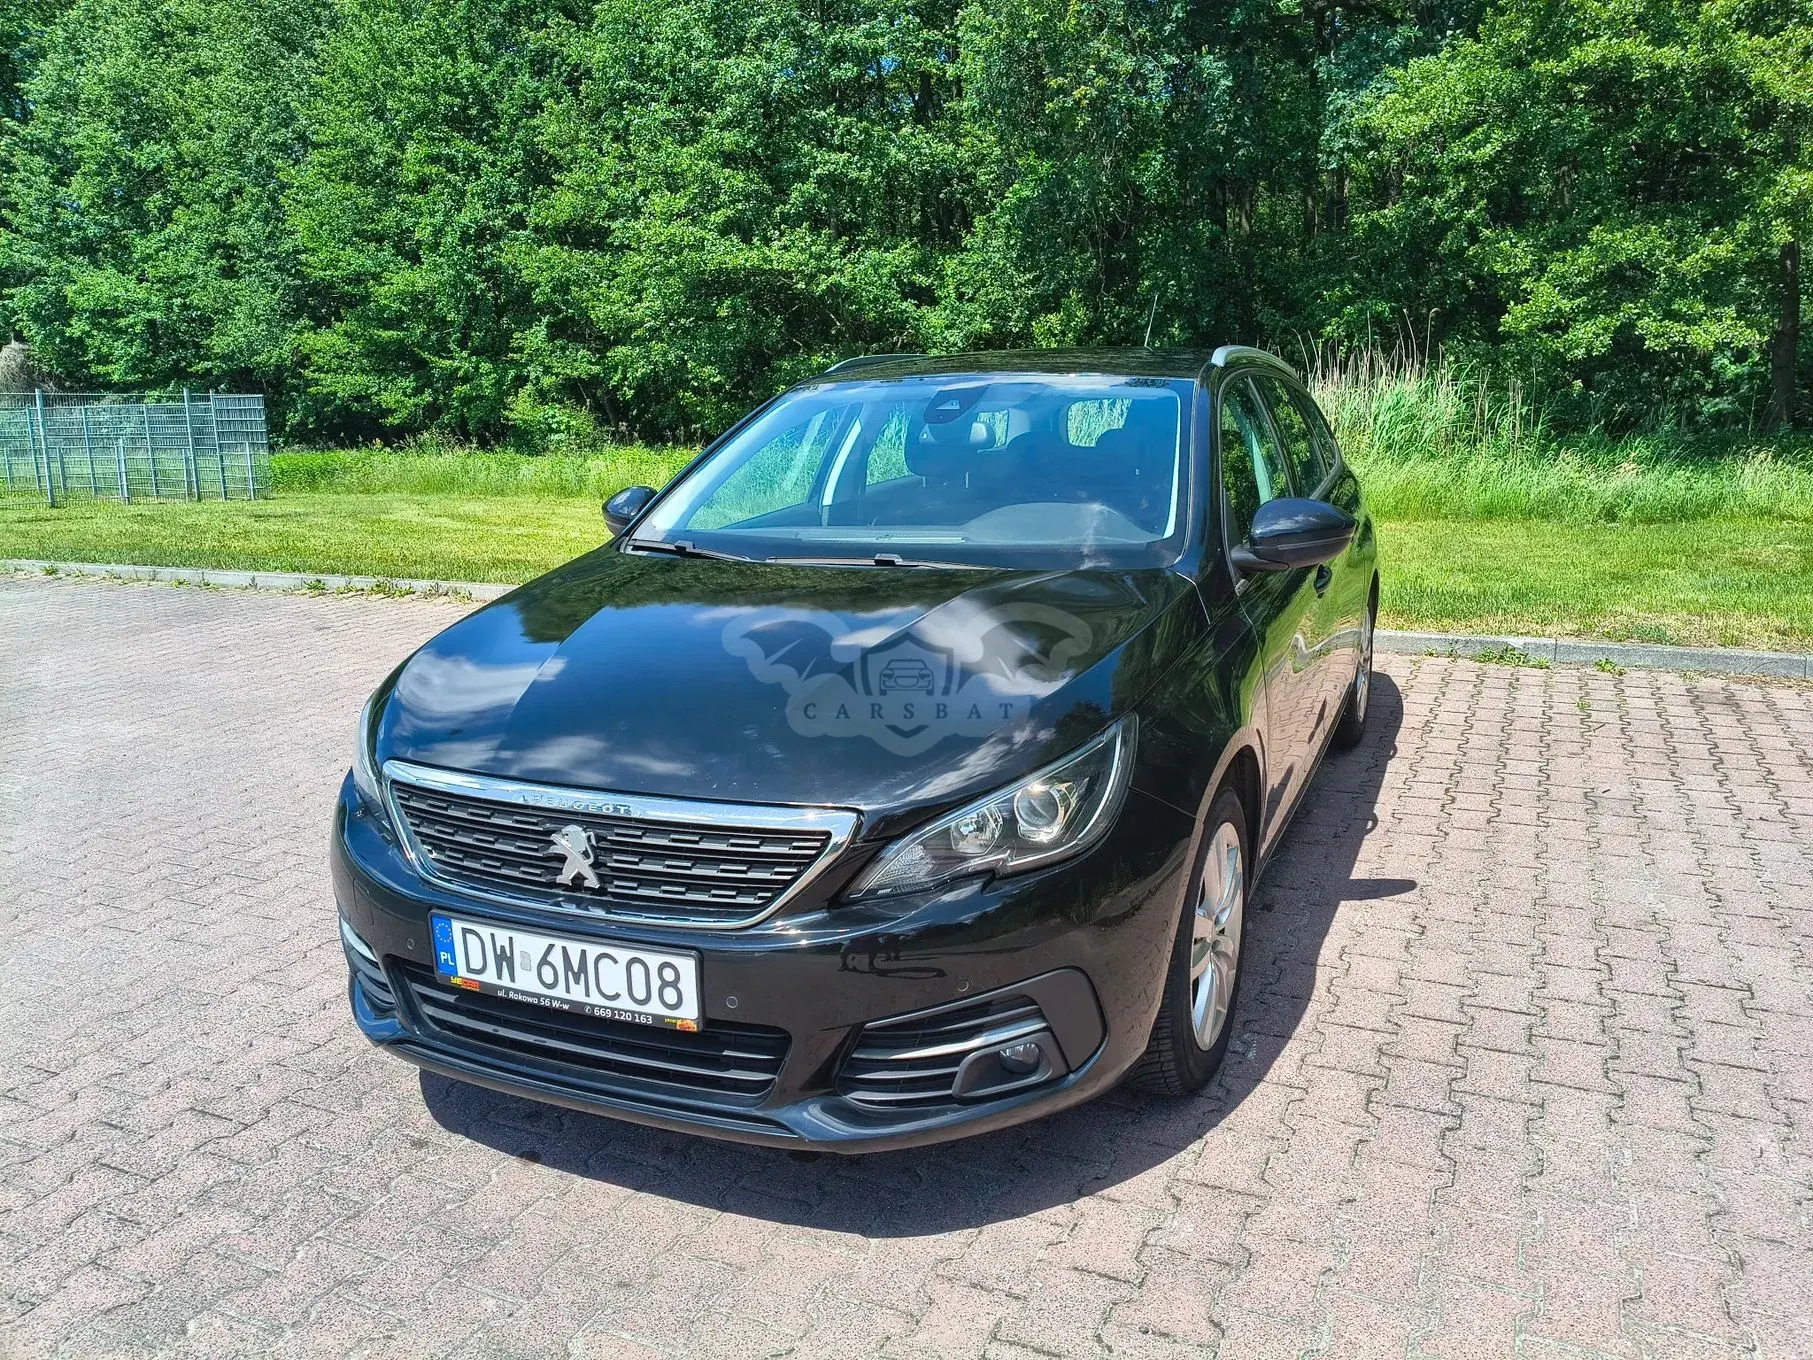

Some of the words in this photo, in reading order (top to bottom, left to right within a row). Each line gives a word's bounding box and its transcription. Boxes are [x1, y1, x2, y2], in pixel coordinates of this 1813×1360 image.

[533, 794, 632, 815] PEUGEOT
[440, 951, 455, 966] PL
[461, 926, 515, 983] DW
[497, 989, 507, 998] ul.
[540, 997, 550, 1006] 56
[593, 1007, 612, 1018] 669
[614, 1010, 632, 1021] 120
[634, 1013, 653, 1024] 163
